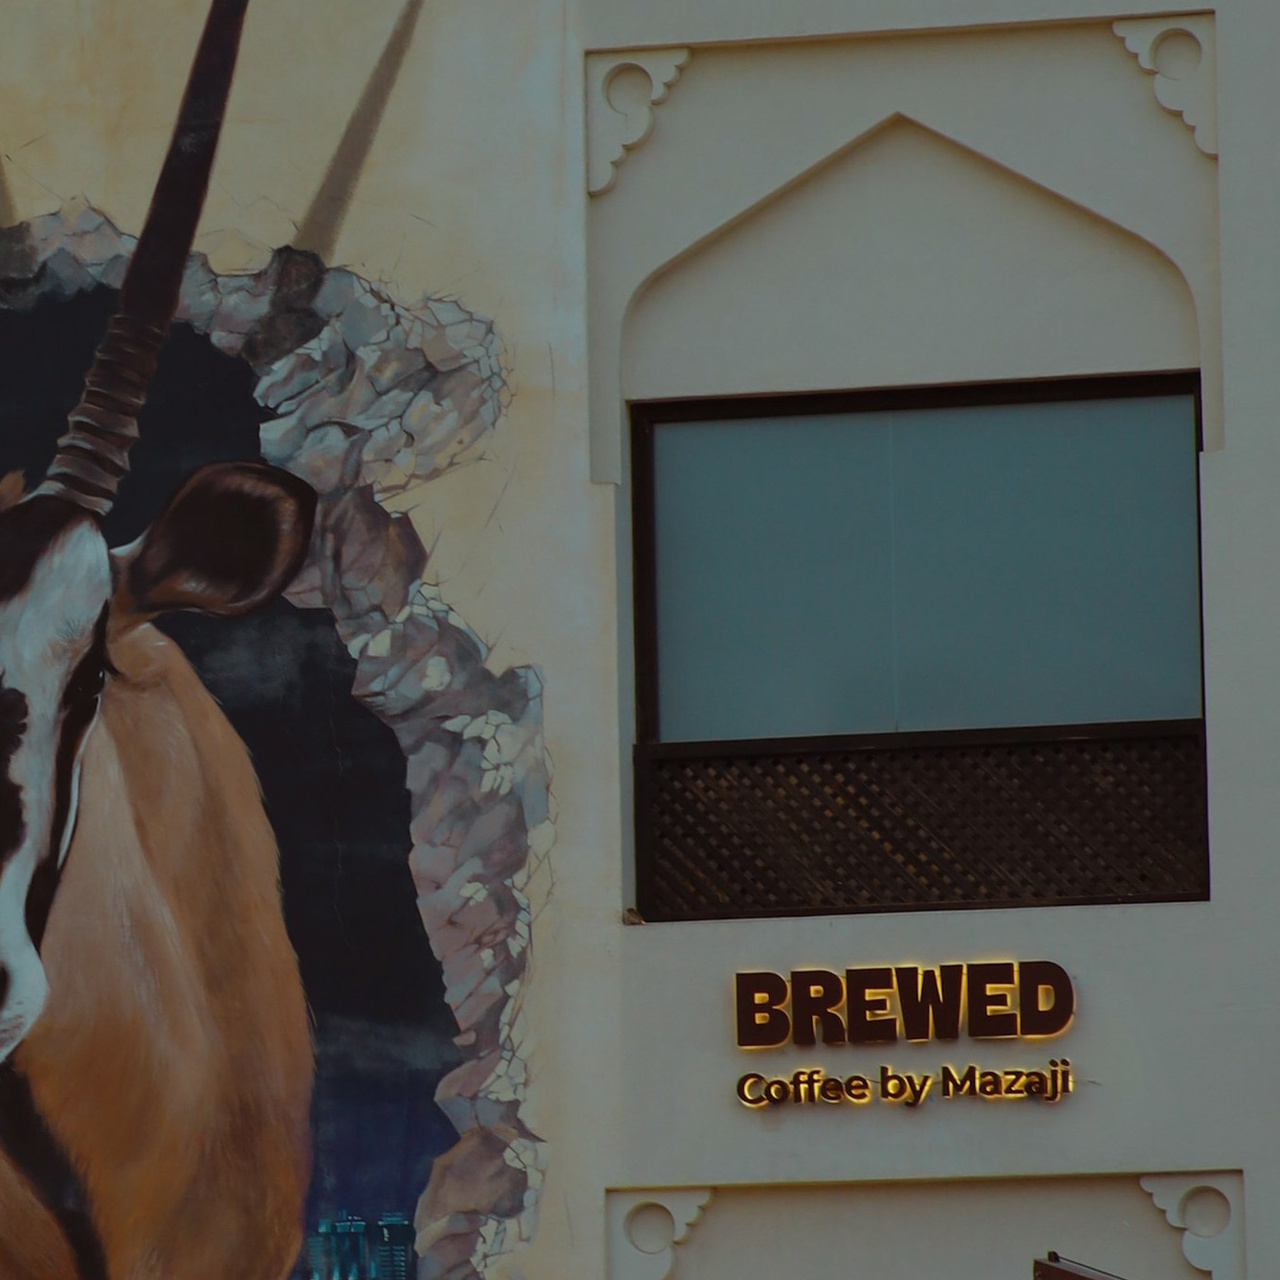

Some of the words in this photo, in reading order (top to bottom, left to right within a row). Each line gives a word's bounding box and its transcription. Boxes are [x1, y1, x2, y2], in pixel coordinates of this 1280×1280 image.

[735, 960, 1074, 1046] BREWED
[737, 1069, 869, 1105] Coffee
[880, 1066, 931, 1107] by
[942, 1059, 1071, 1102] Mazaji
